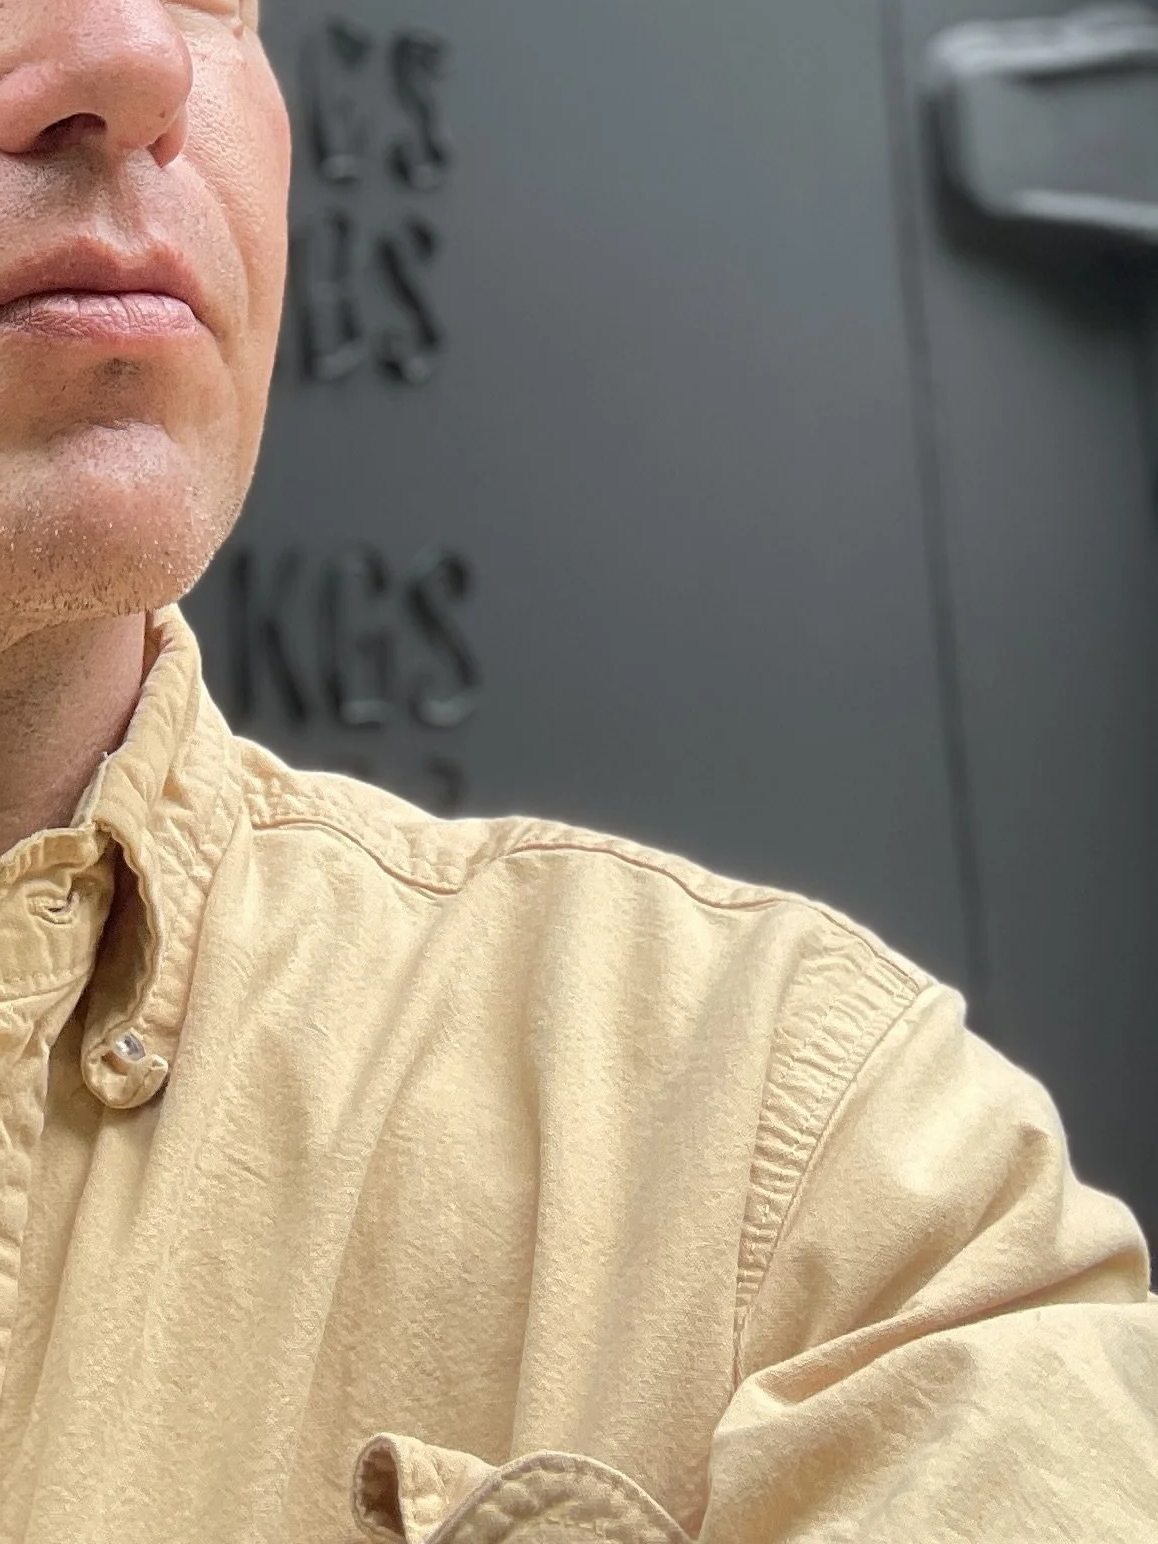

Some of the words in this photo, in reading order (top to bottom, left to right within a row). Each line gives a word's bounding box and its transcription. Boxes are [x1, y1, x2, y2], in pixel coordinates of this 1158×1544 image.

[296, 18, 452, 192] GS
[288, 210, 448, 386] BS
[226, 539, 484, 731] KGS
